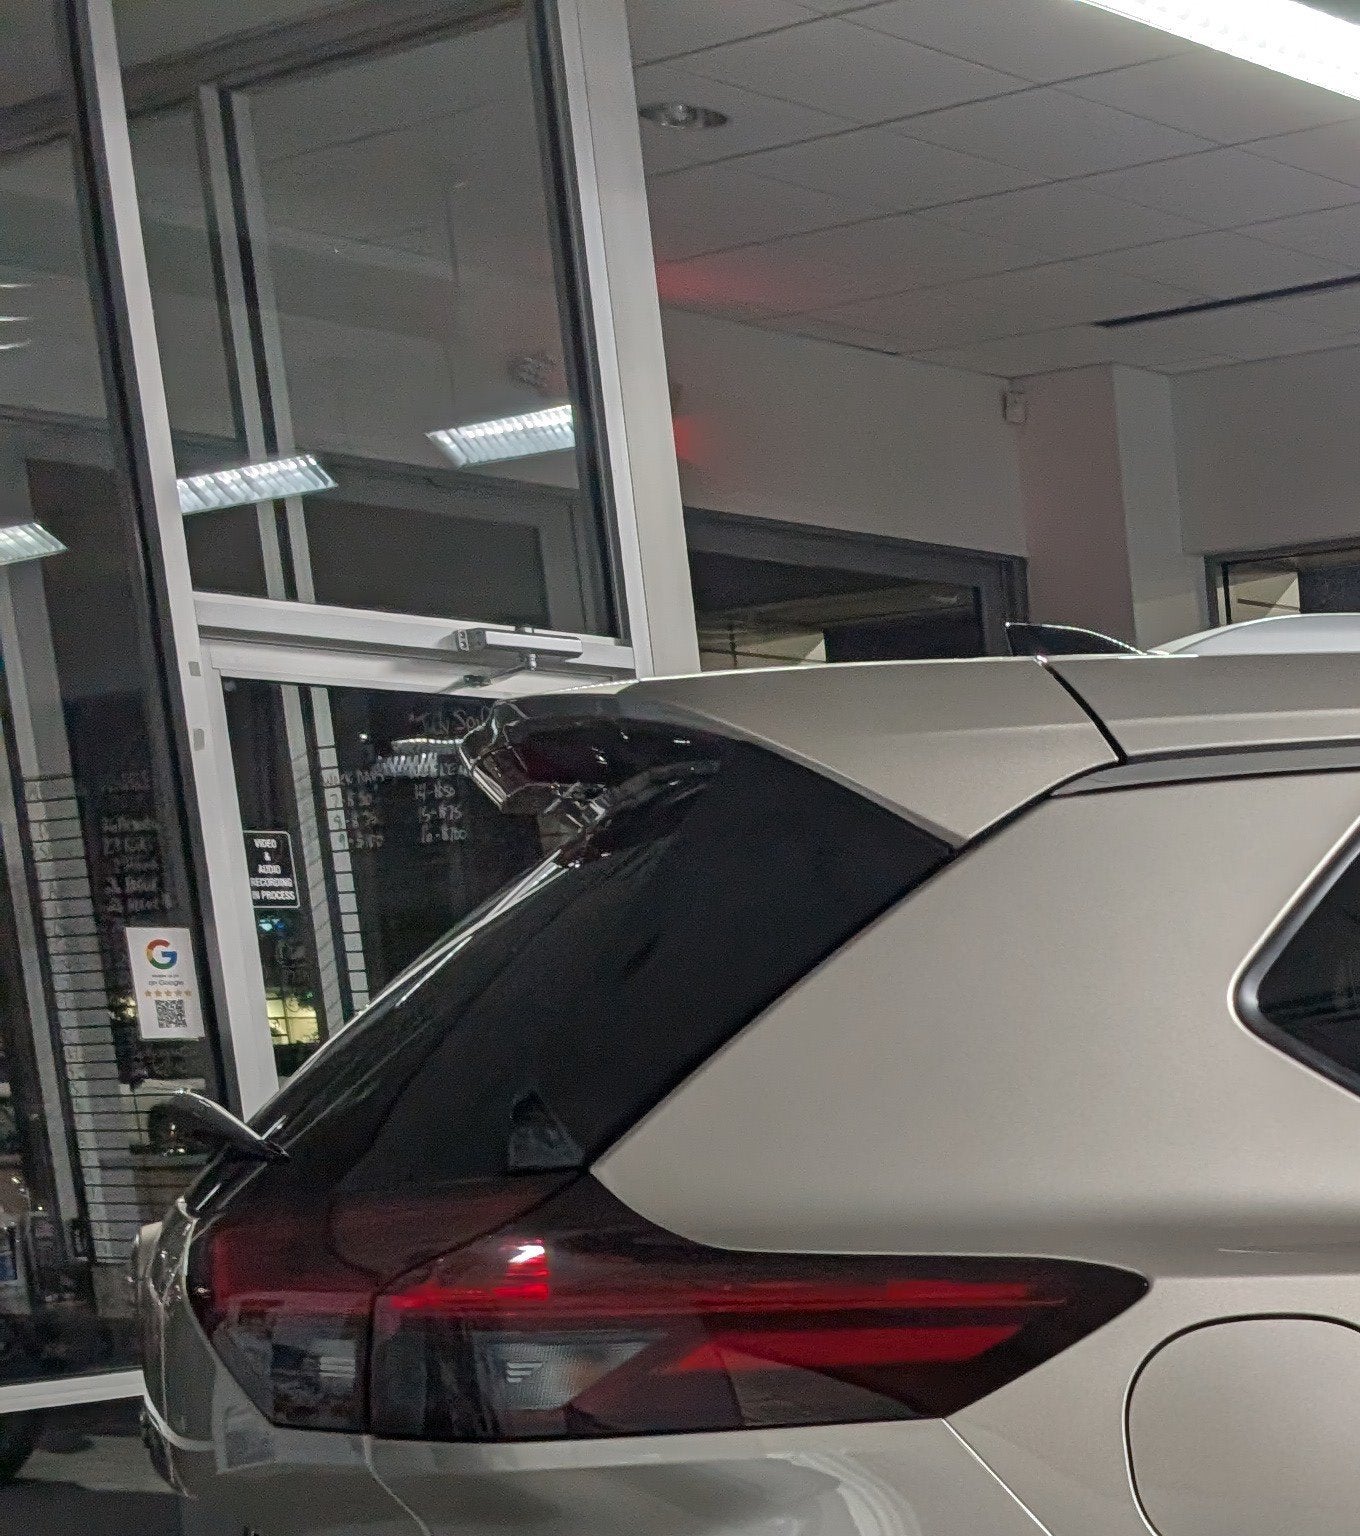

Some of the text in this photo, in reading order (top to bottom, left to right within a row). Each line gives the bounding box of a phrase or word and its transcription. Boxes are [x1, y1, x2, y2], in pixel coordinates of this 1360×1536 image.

[253, 838, 277, 849] VIDEO
[264, 851, 272, 861] &
[258, 864, 281, 874] AUDIO
[261, 890, 296, 900] PROCESS
